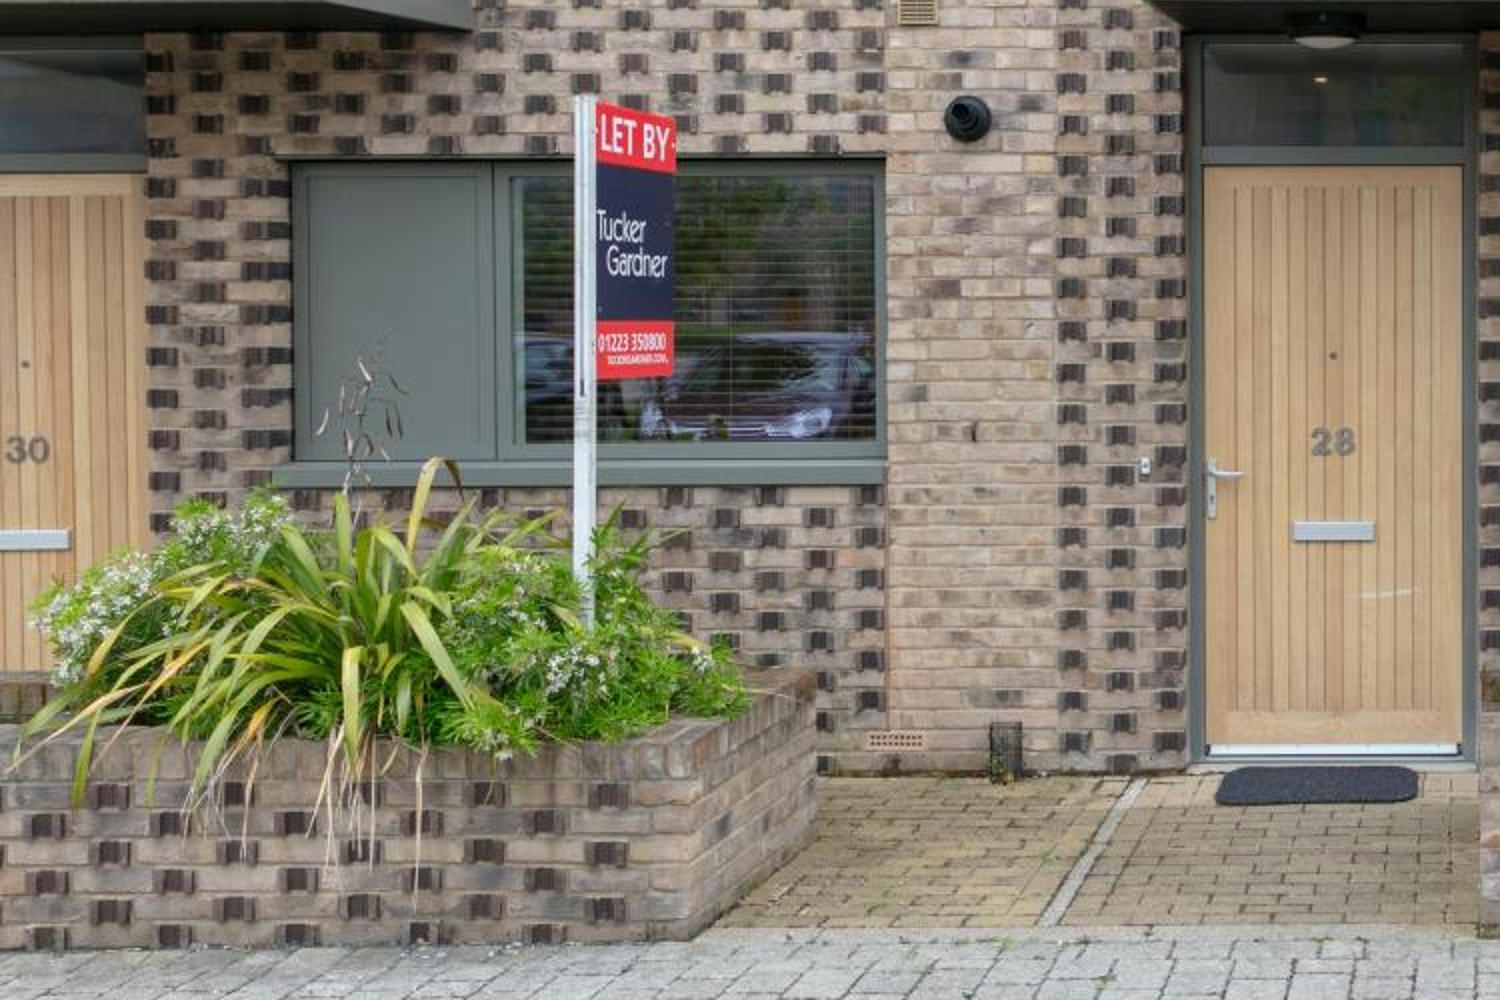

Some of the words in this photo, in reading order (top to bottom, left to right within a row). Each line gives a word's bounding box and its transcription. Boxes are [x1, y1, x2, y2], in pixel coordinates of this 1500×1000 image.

[601, 113, 637, 156] LET
[643, 122, 671, 161] BY
[597, 209, 647, 244] Tucker
[606, 245, 669, 278] Gardner
[598, 332, 629, 353] 01223
[5, 435, 50, 464] 30
[1311, 427, 1356, 457] 28
